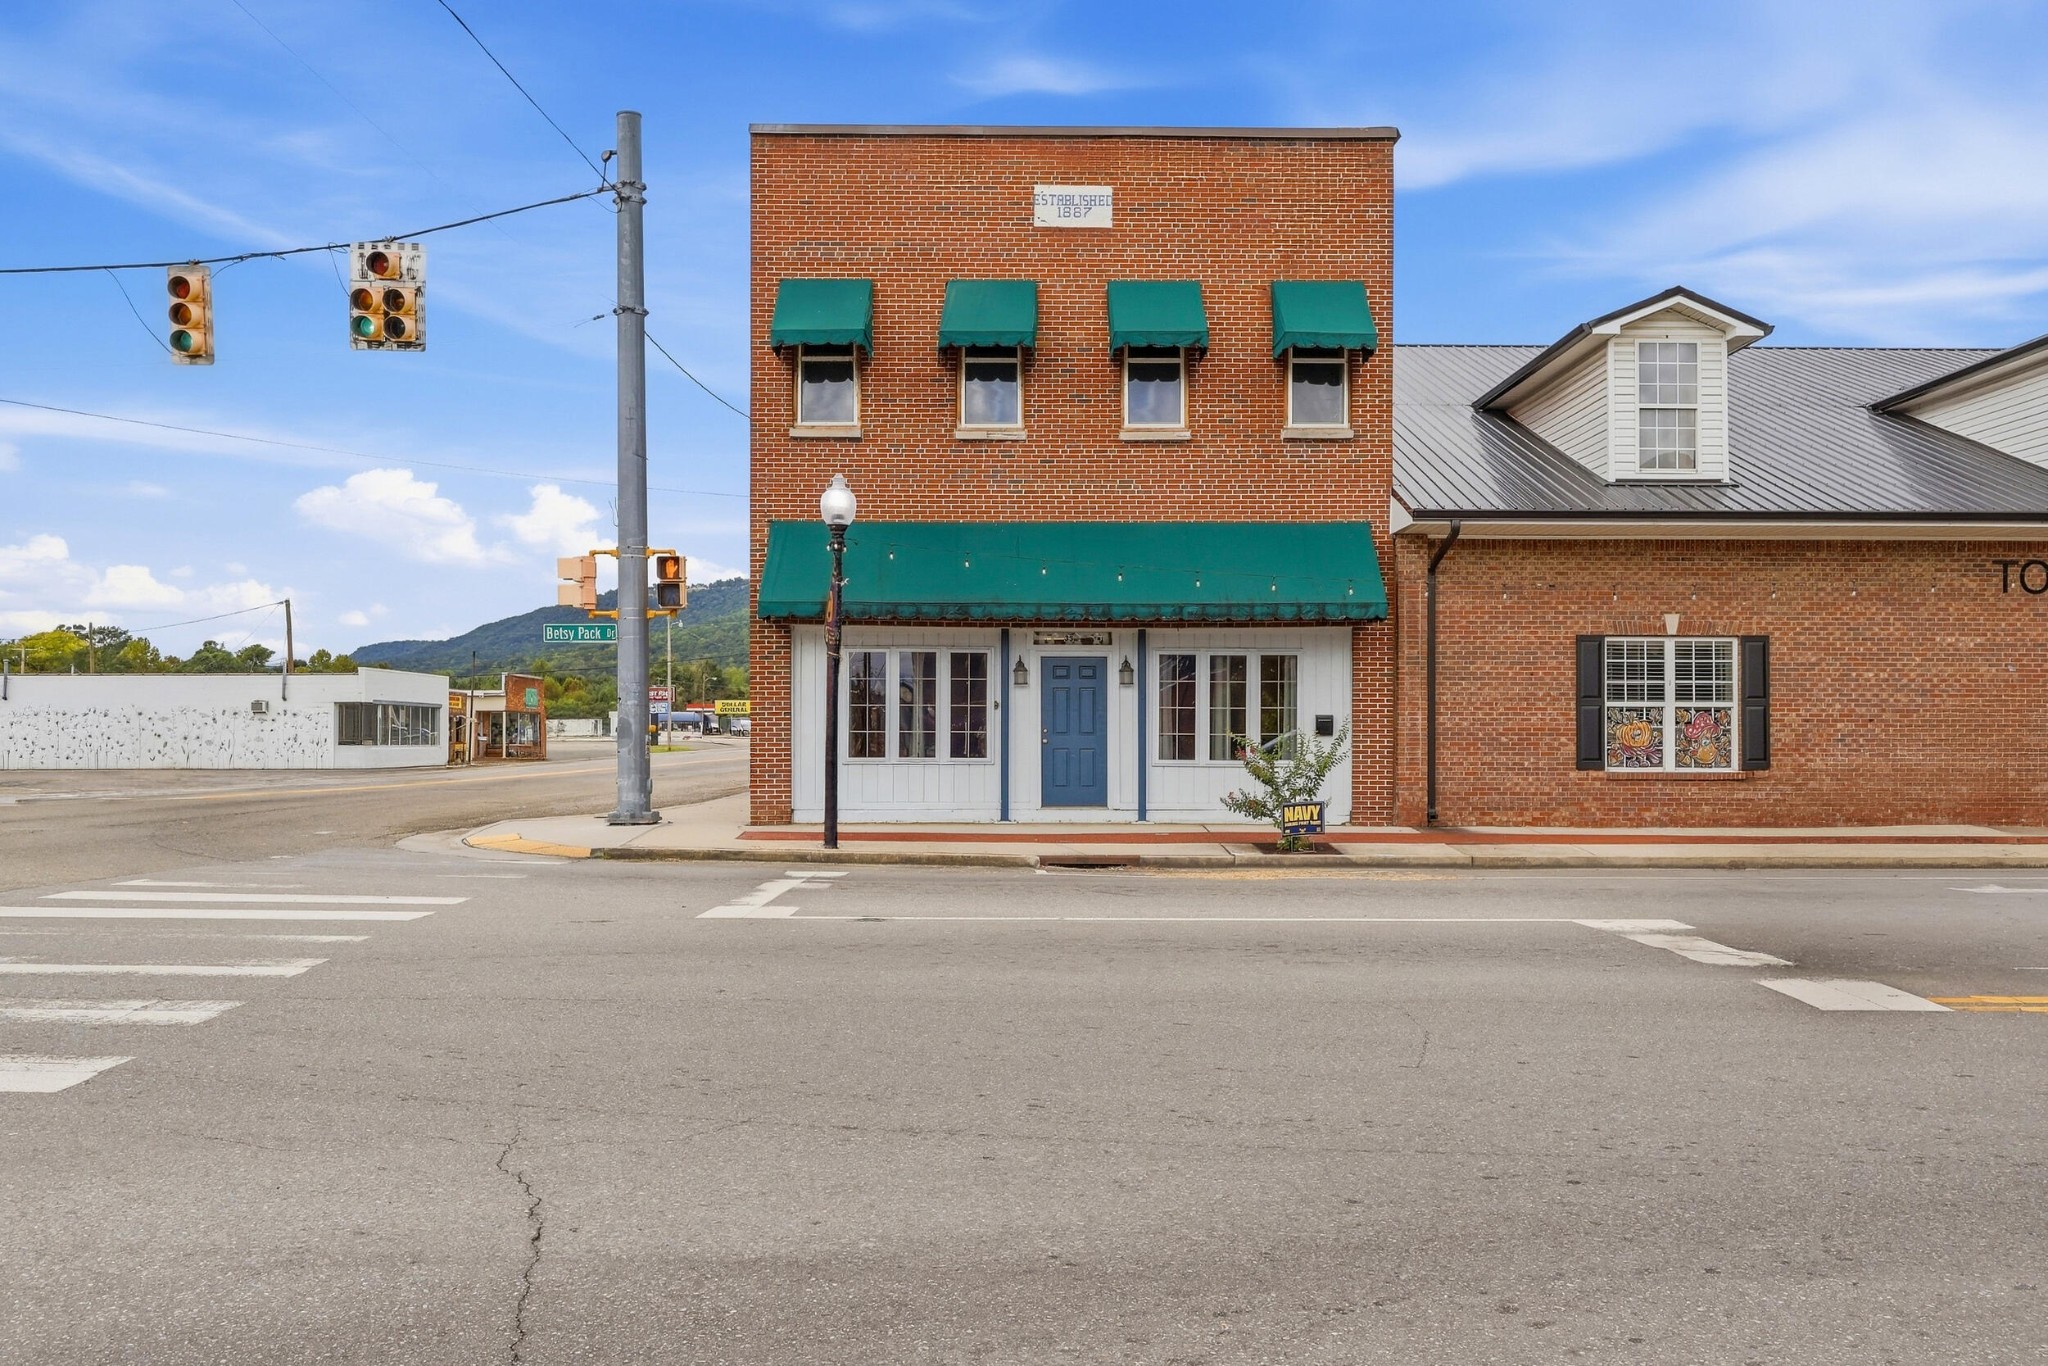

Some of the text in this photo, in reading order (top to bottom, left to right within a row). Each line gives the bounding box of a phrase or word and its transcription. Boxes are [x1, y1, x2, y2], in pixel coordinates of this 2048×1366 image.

[1034, 194, 1113, 206] ESTABLISHED
[1991, 559, 2048, 594] TO
[546, 627, 616, 640] Betsy Pack Dr
[1284, 805, 1320, 822] NAVY
